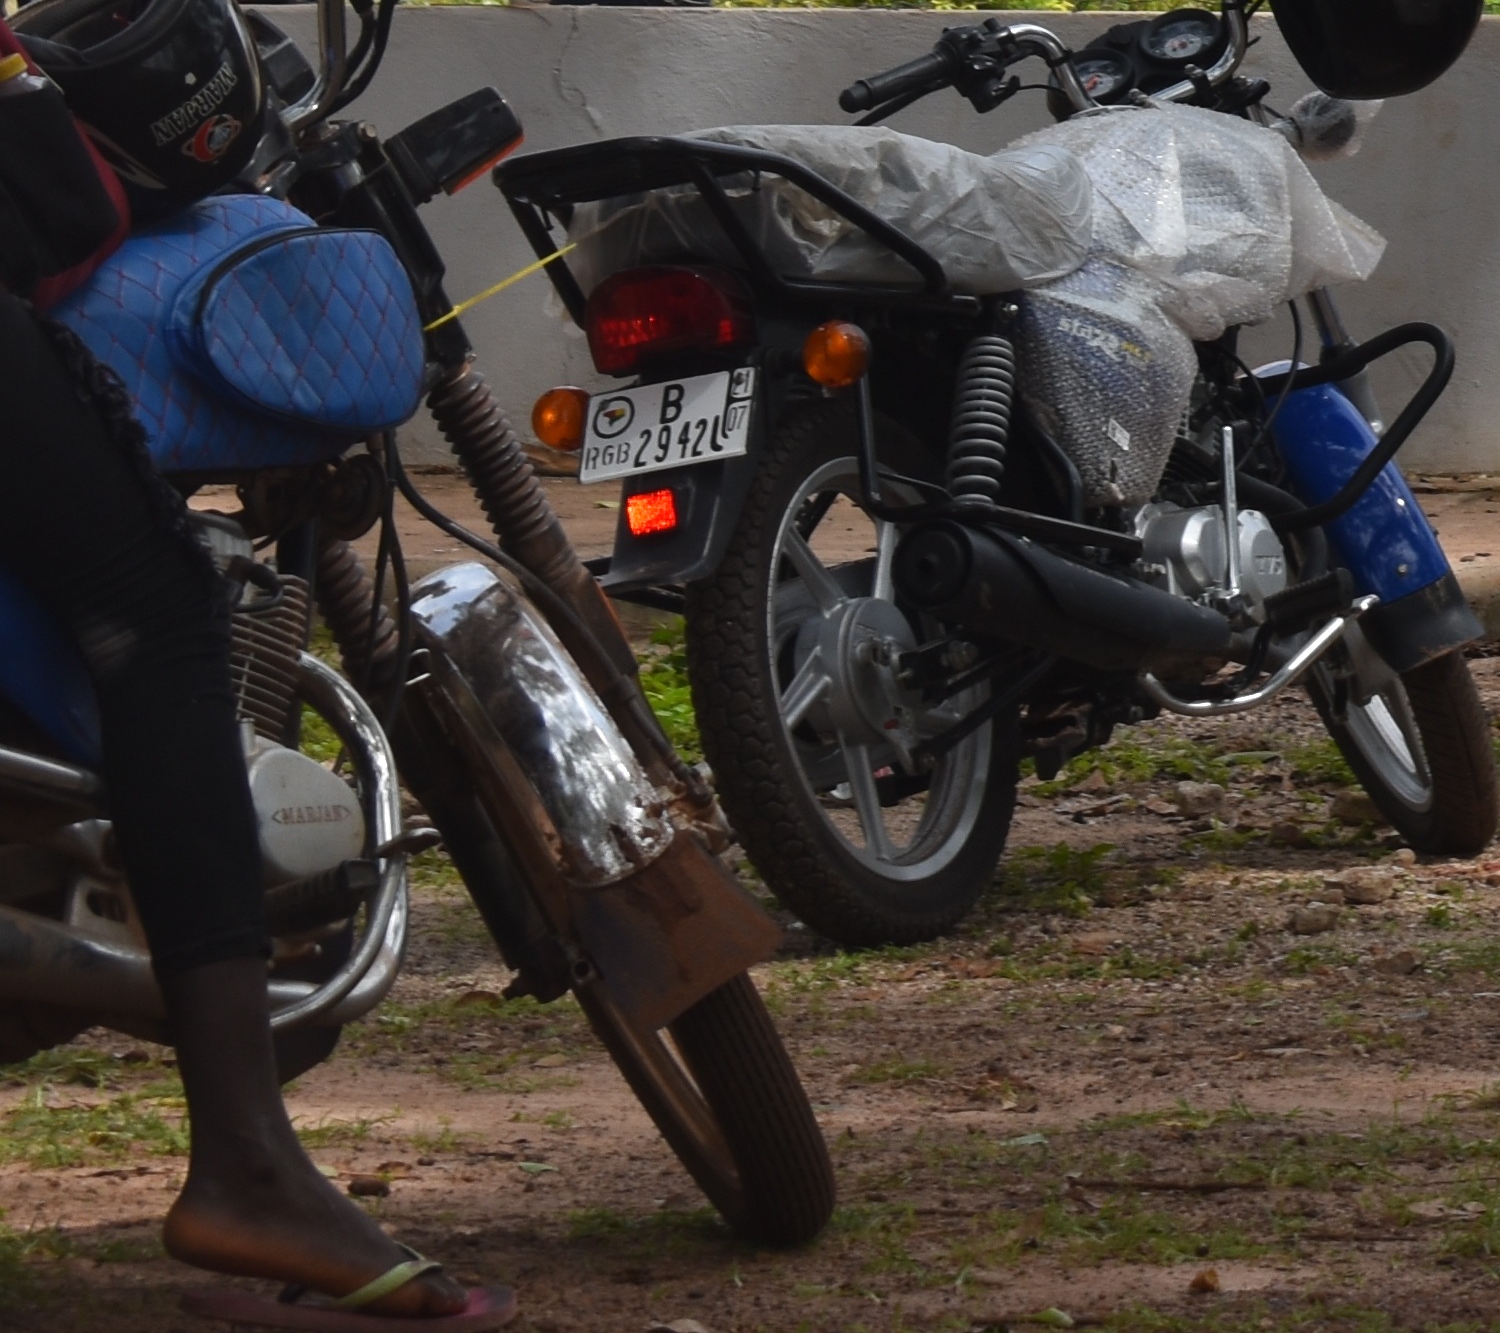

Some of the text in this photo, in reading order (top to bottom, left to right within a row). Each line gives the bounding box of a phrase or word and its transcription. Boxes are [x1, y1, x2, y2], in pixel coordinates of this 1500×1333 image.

[659, 383, 685, 425] B
[727, 405, 748, 432] 07
[584, 441, 632, 471] RGB
